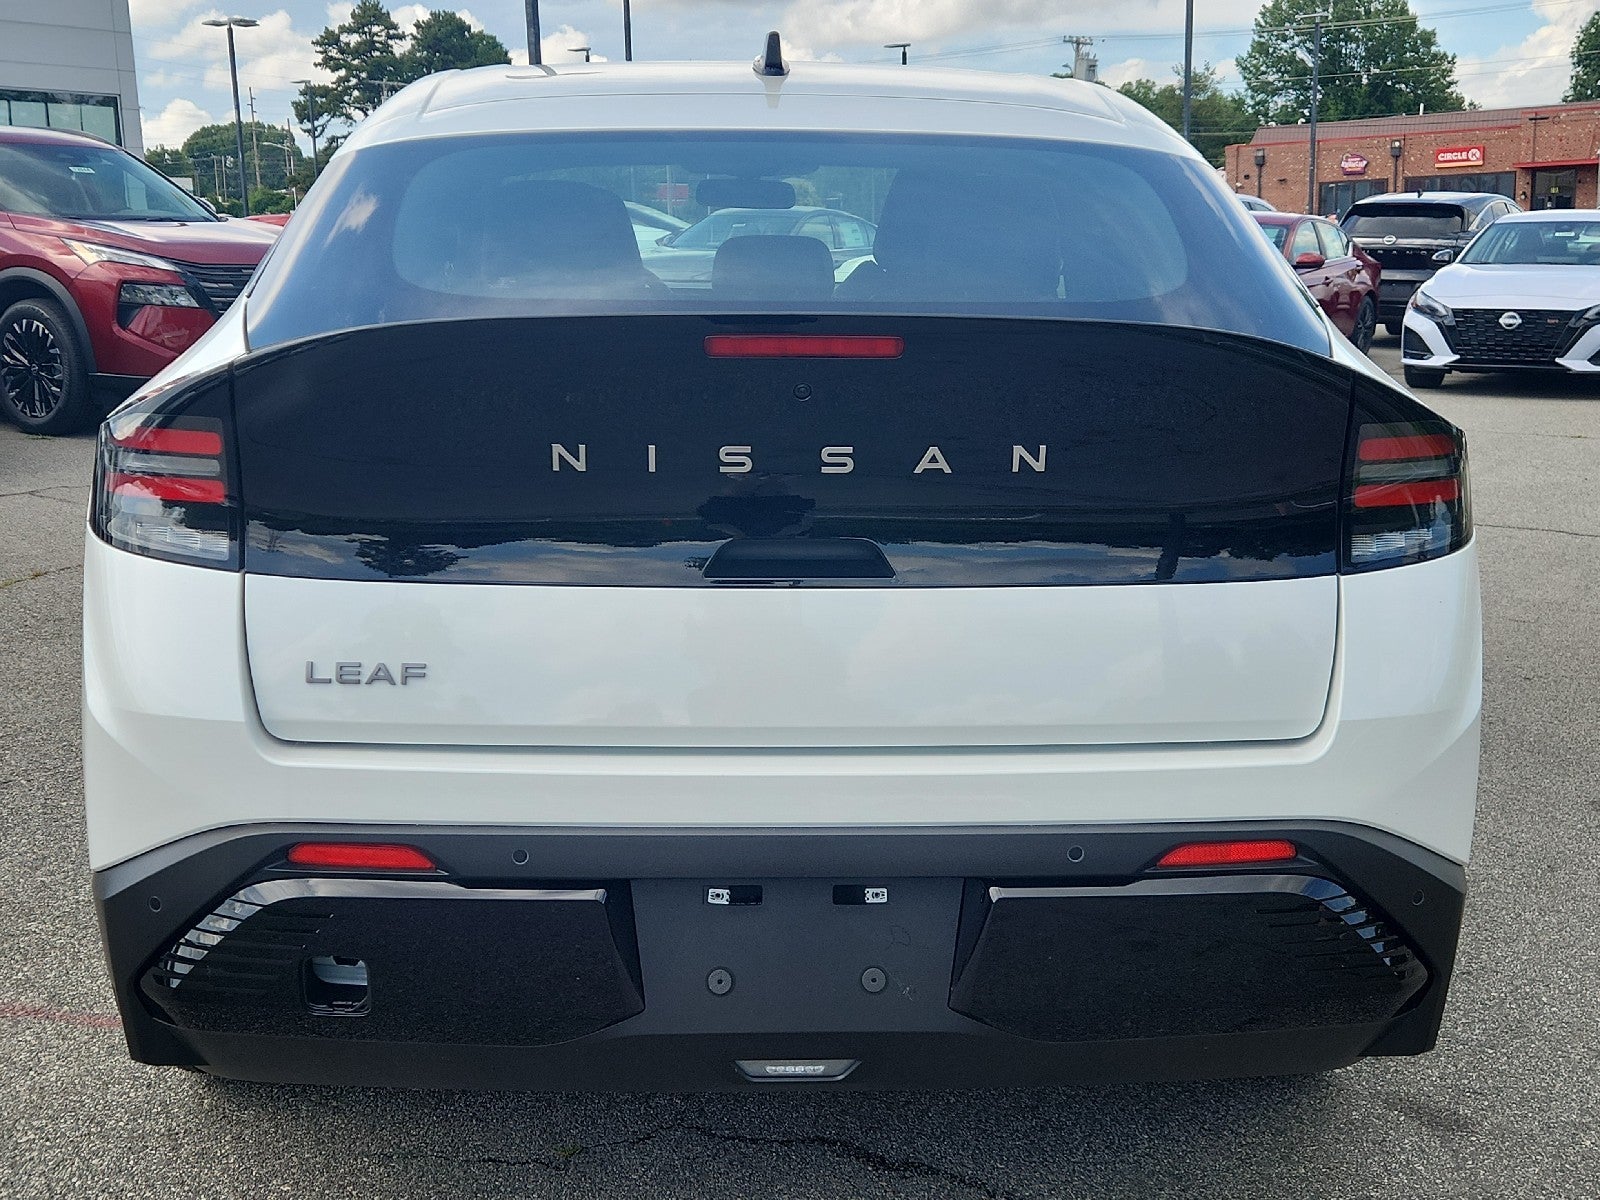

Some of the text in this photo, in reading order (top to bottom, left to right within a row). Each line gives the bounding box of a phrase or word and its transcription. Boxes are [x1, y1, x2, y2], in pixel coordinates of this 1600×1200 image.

[1438, 150, 1480, 161] CIRCLE K
[551, 443, 1047, 475] NISSAN
[305, 660, 427, 686] LEAF
